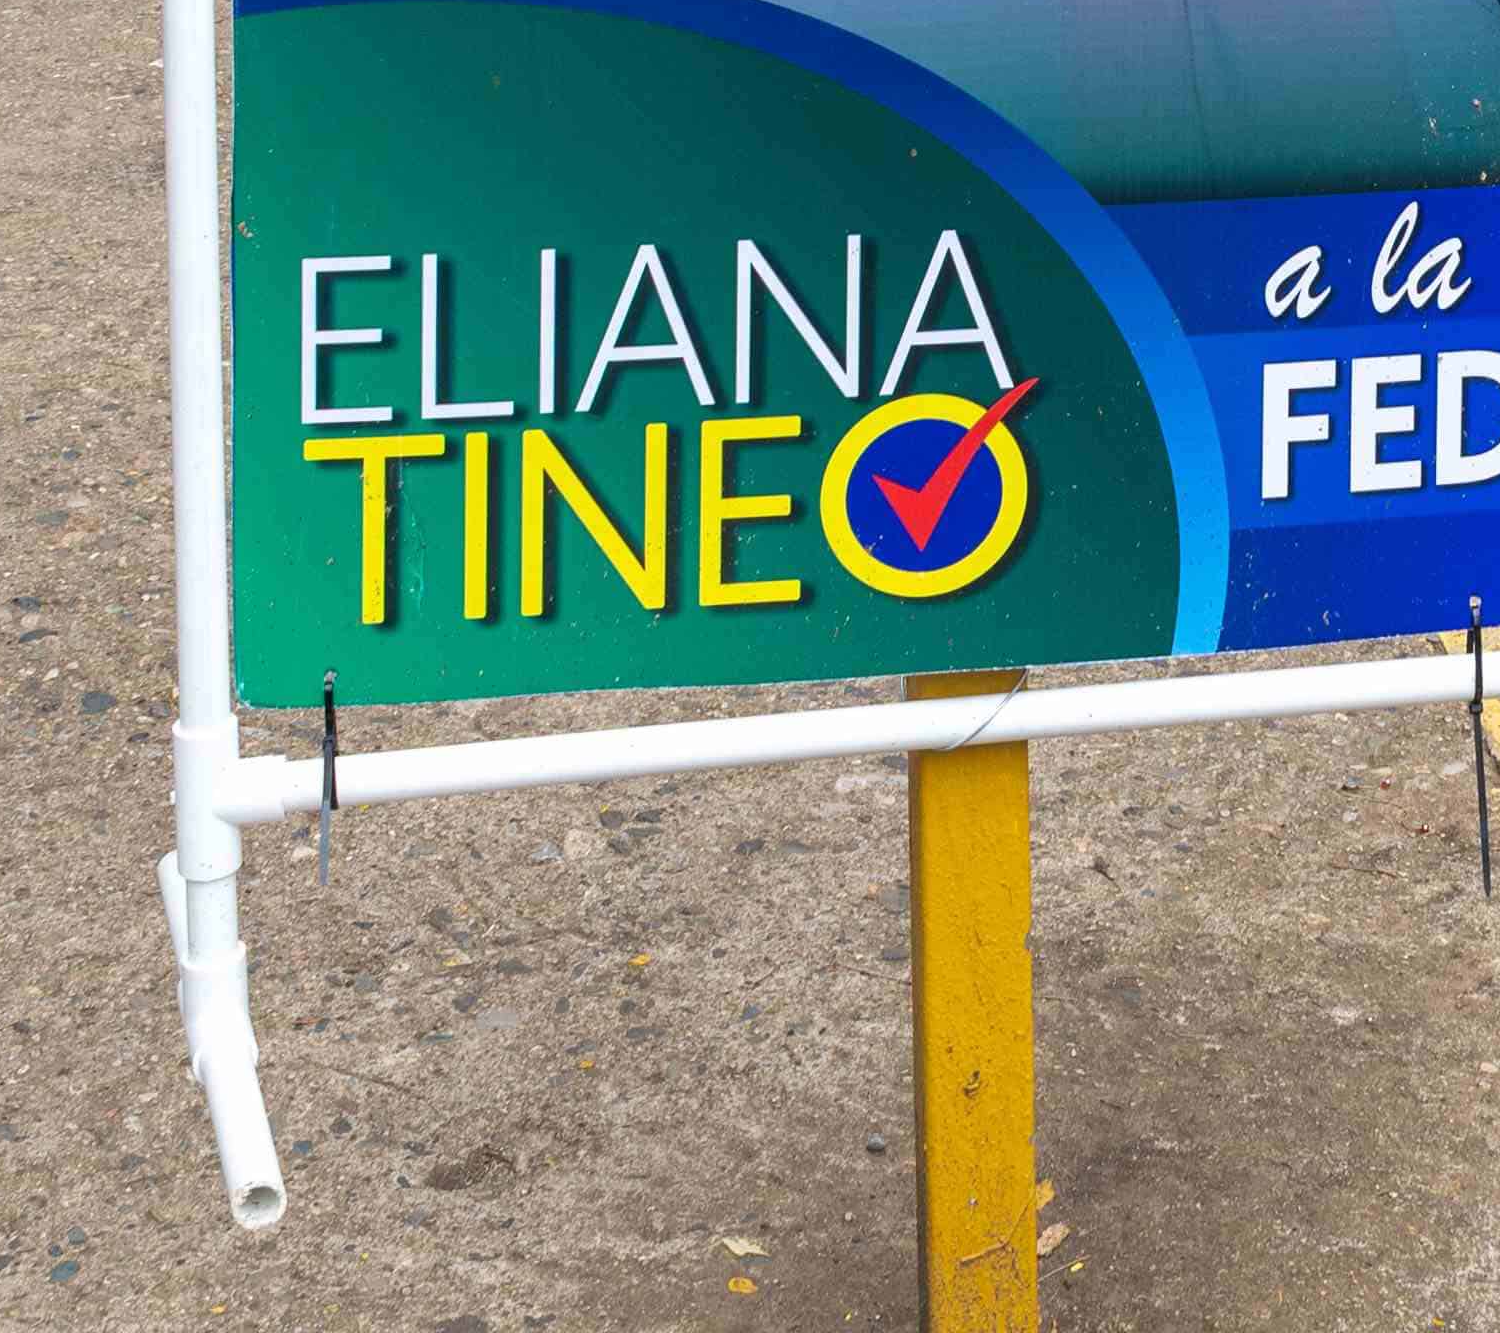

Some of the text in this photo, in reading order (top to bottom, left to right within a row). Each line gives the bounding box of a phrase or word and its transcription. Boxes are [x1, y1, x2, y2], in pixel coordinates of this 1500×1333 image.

[301, 229, 1015, 424] ELIANA
[1264, 200, 1472, 320] a la
[303, 391, 1029, 624] TINEO
